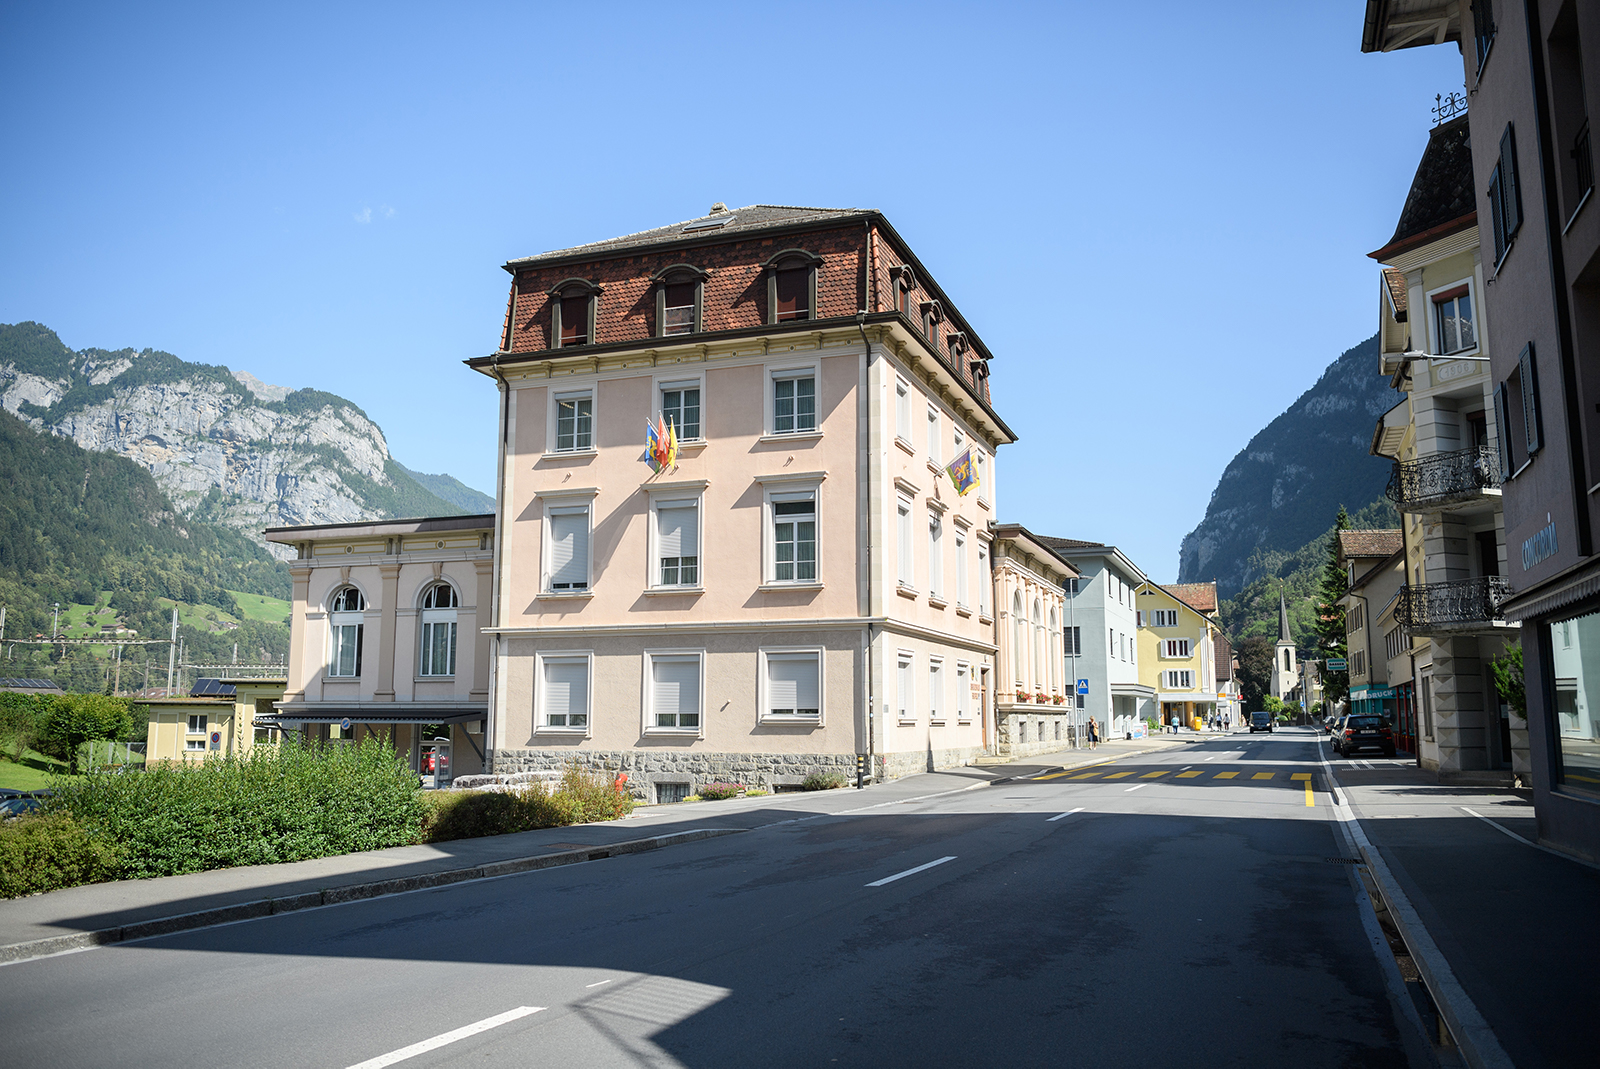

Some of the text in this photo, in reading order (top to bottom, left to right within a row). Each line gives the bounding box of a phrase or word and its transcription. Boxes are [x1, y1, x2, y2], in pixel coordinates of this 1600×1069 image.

[1444, 362, 1470, 377] 1906
[1521, 521, 1559, 571] CONCORDIA
[1367, 690, 1393, 699] DRUCK
